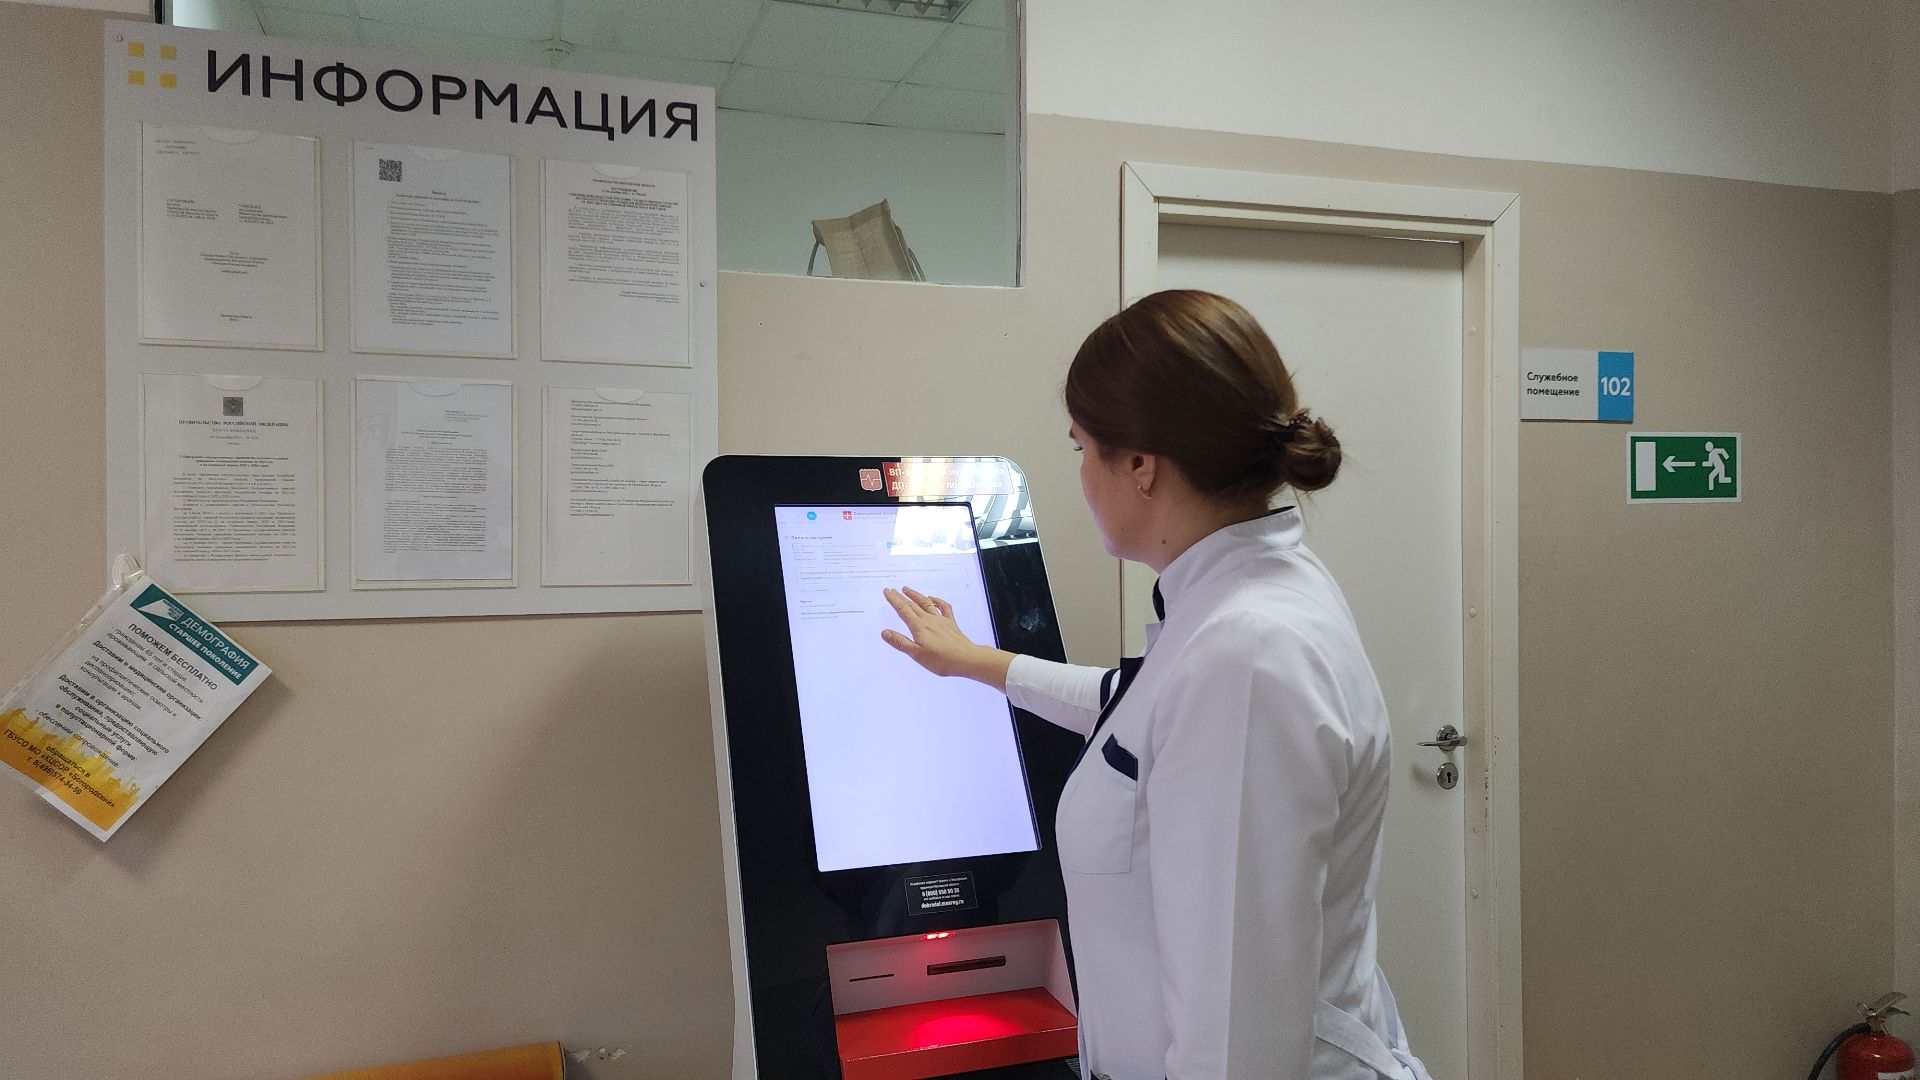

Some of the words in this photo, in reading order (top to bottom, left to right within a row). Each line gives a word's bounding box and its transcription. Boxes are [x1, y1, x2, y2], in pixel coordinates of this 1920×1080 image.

[207, 48, 699, 141] ИНФОРМАЦИЯ
[1526, 372, 1579, 383] Служебное
[1526, 388, 1580, 396] помещение
[1600, 376, 1631, 396] 102
[127, 622, 172, 656] ПОМОЖЕМ
[170, 653, 218, 690] БЕСПЛАТНО
[168, 622, 202, 648] СТАРШЕЕ
[199, 646, 242, 679] ПОКОЛЕНИЕ
[180, 615, 250, 669] ДЕМОГРАФИЯ
[92, 639, 124, 663] Доставим
[127, 664, 166, 694] медицинские
[3, 728, 29, 747] ГБУСО
[57, 673, 90, 697] Доставим
[94, 698, 134, 727] организацию
[132, 725, 169, 754] социального
[73, 705, 112, 733] социальные
[110, 731, 132, 747] услуги
[44, 744, 86, 774] обращаться
